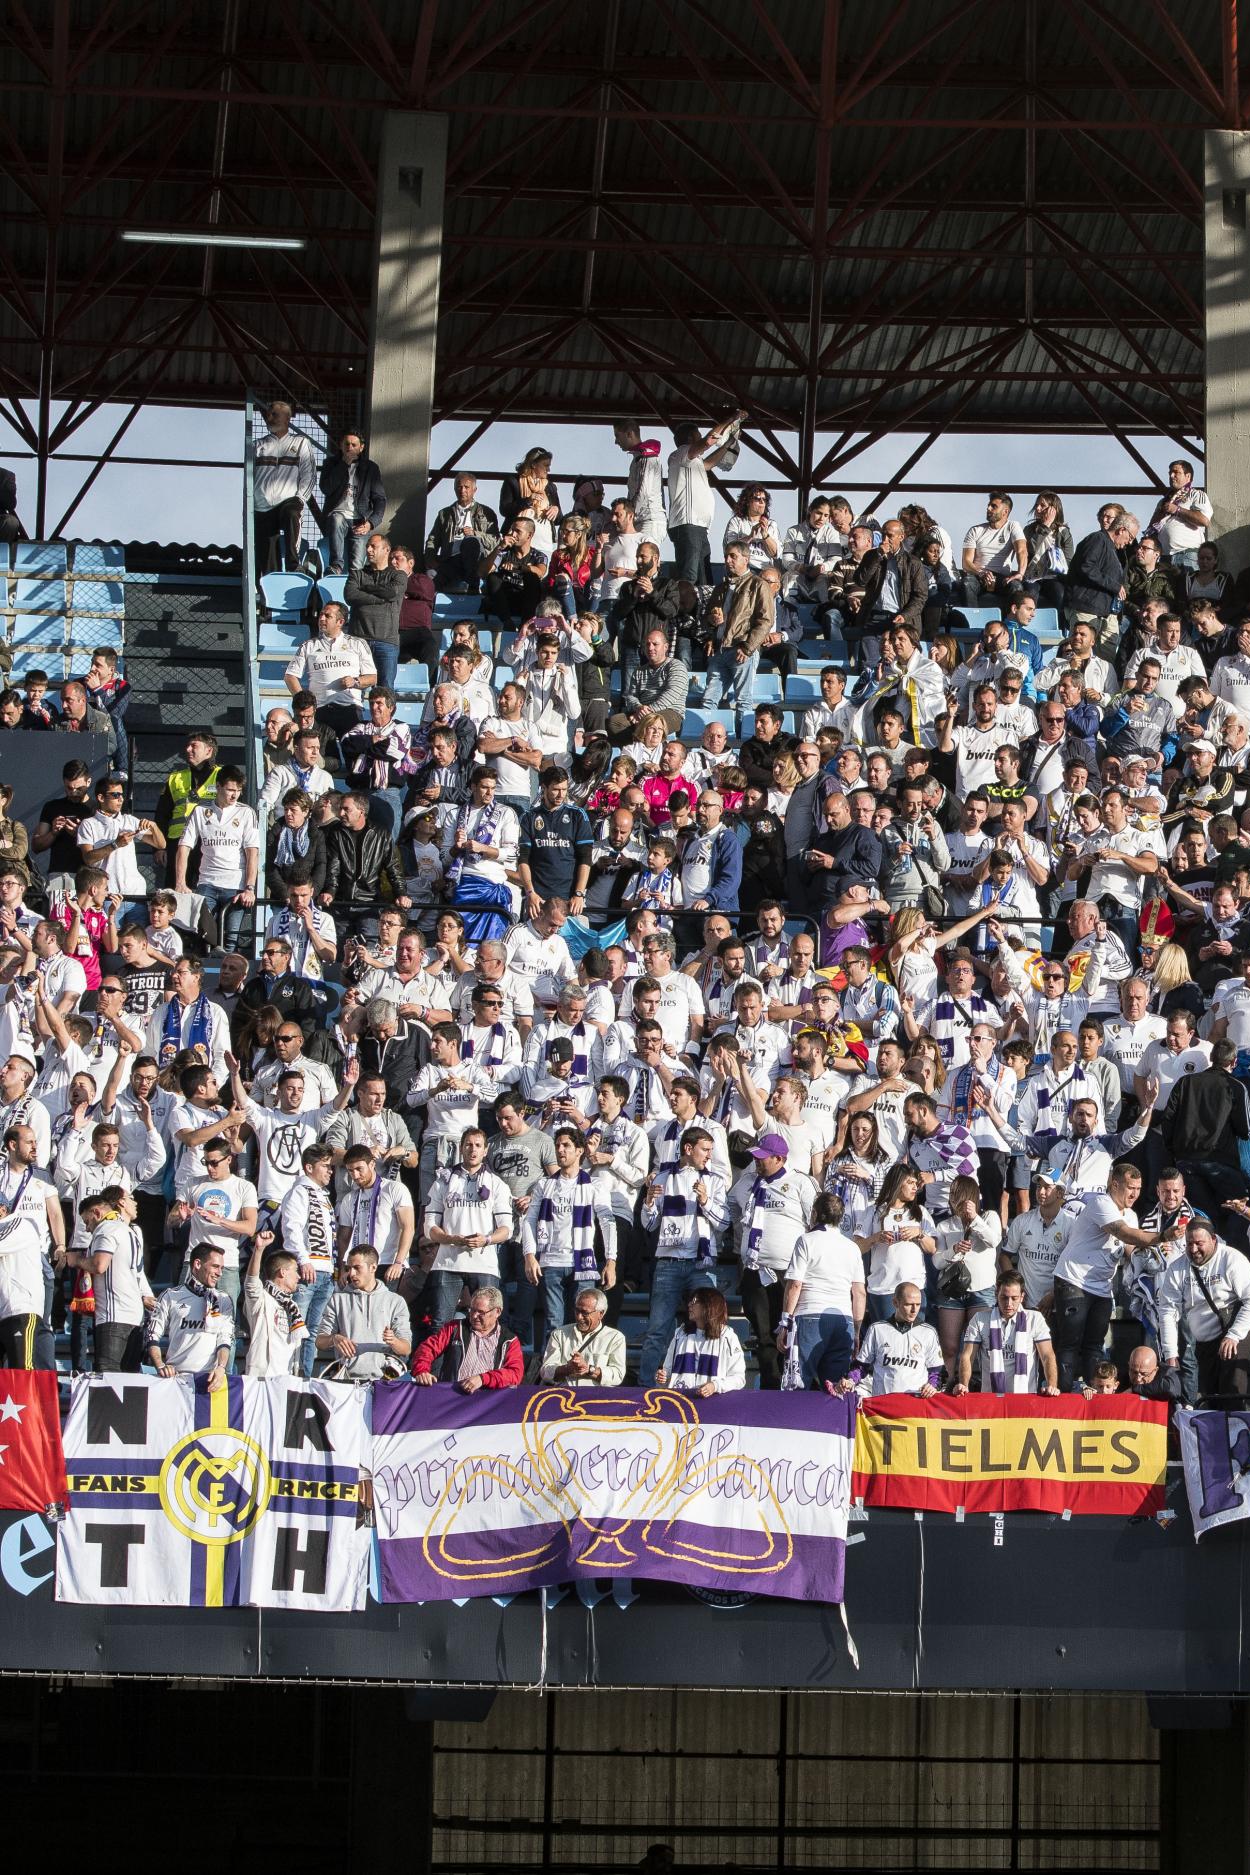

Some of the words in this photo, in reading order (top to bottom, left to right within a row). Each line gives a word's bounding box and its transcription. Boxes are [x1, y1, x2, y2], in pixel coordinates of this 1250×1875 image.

[313, 660, 351, 670] Emirates
[1163, 666, 1174, 674] Fly
[1239, 672, 1249, 680] Fly
[547, 832, 558, 840] Fly
[202, 837, 239, 847] Emirates
[536, 838, 570, 848] Emirates
[536, 959, 548, 967] Fly
[1130, 1042, 1143, 1050] Fly
[1116, 1050, 1144, 1060] Emira
[874, 1101, 895, 1113] win
[515, 1164, 529, 1178] 88
[1037, 1243, 1049, 1252] Fly
[1025, 1249, 1060, 1261] Emirate
[883, 1354, 917, 1368] bwin
[87, 1386, 148, 1445] N
[284, 1391, 334, 1452] R
[869, 1424, 1141, 1475] TIELMES
[672, 1428, 845, 1509] blanca
[73, 1476, 146, 1493] FANS
[277, 1480, 355, 1499] RMCF
[85, 1524, 145, 1588] T
[272, 1528, 330, 1595] H
